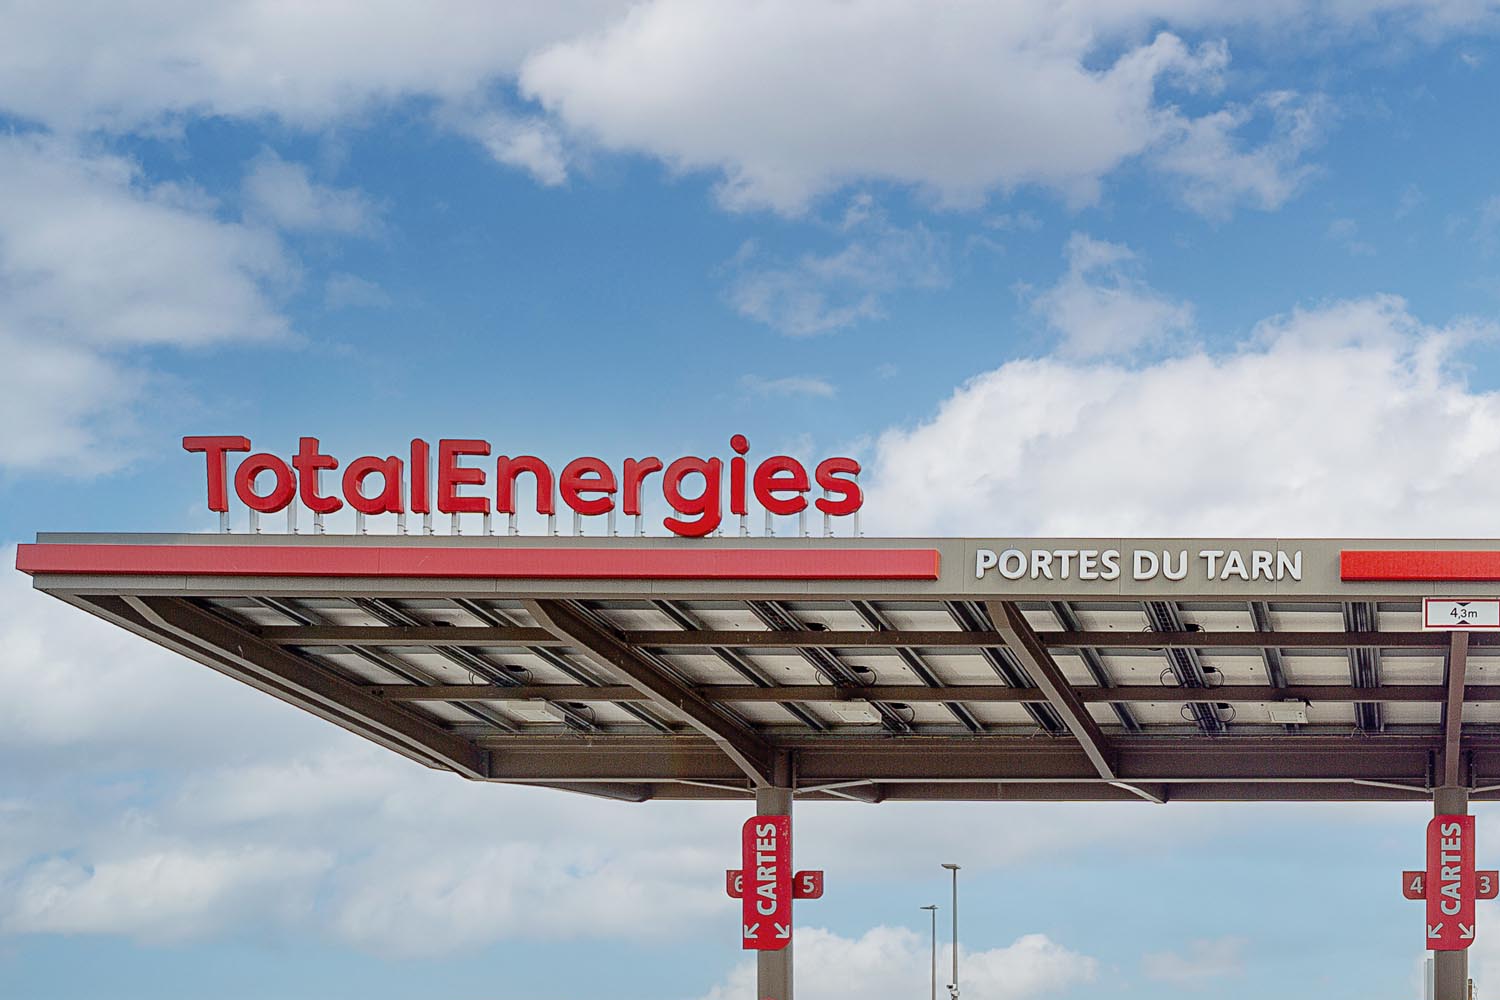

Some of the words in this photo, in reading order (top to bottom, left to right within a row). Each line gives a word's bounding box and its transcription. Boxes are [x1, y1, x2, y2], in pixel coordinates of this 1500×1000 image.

[182, 434, 864, 537] TotalEnergies
[975, 549, 1121, 581] PORTES
[1132, 549, 1188, 581] DU
[1199, 549, 1302, 581] TARN
[1450, 607, 1478, 619] 4,3m
[756, 823, 777, 916] CARTES
[1441, 822, 1461, 916] CARTES
[802, 875, 815, 893] 5
[1410, 876, 1424, 894] 4
[1479, 876, 1491, 894] 3
